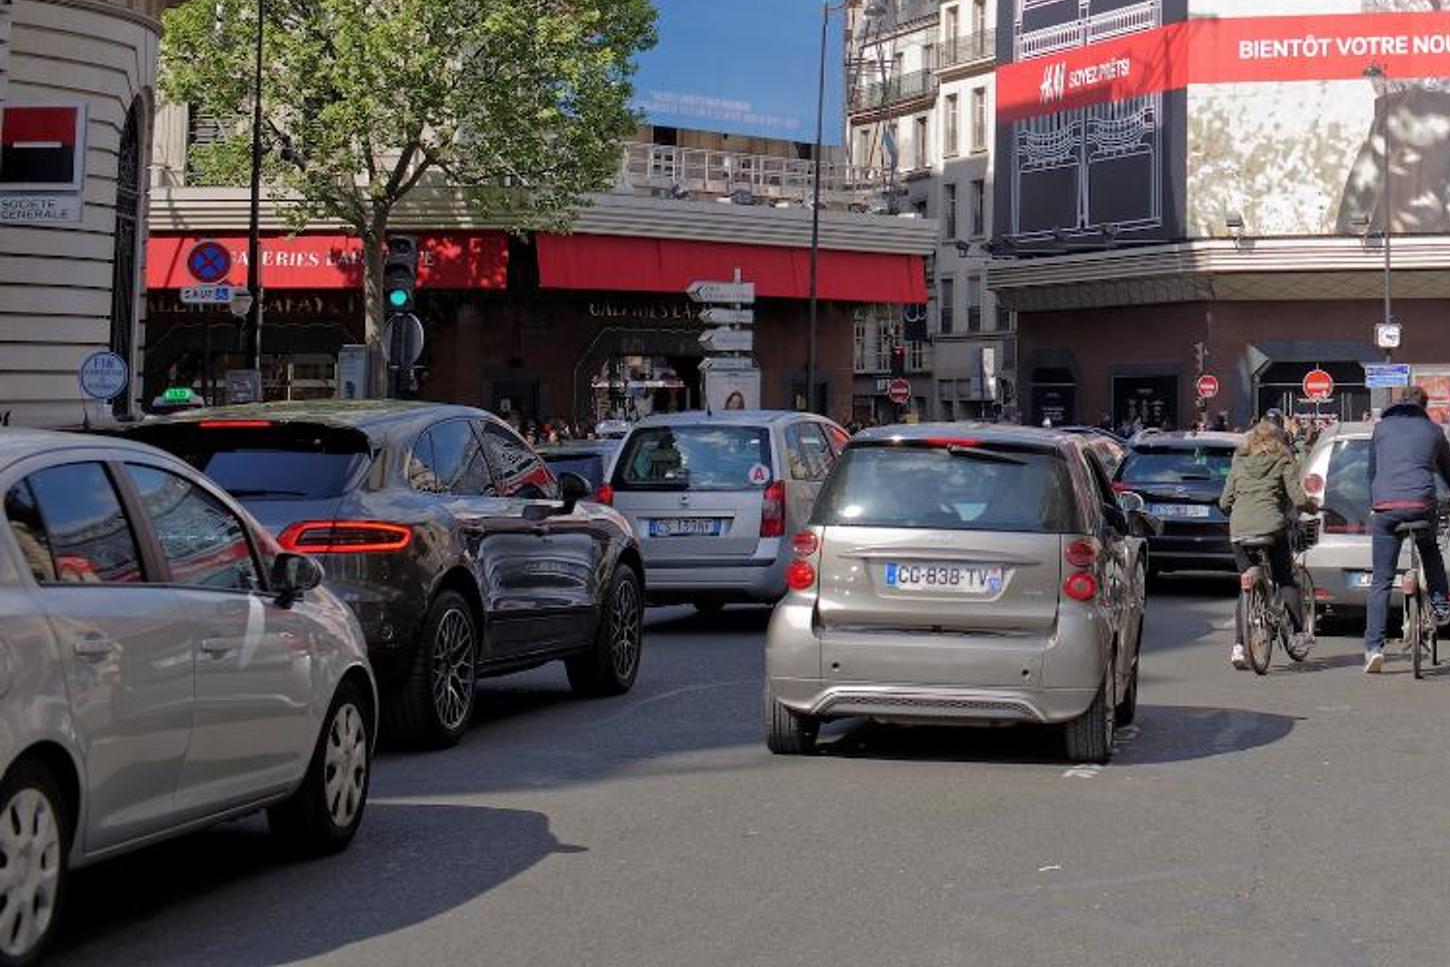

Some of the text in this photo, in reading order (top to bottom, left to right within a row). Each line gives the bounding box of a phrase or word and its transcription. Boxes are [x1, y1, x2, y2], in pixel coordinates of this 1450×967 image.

[1238, 35, 1332, 60] BIENTÔT
[1335, 35, 1408, 57] VOTRE
[753, 466, 765, 481] A
